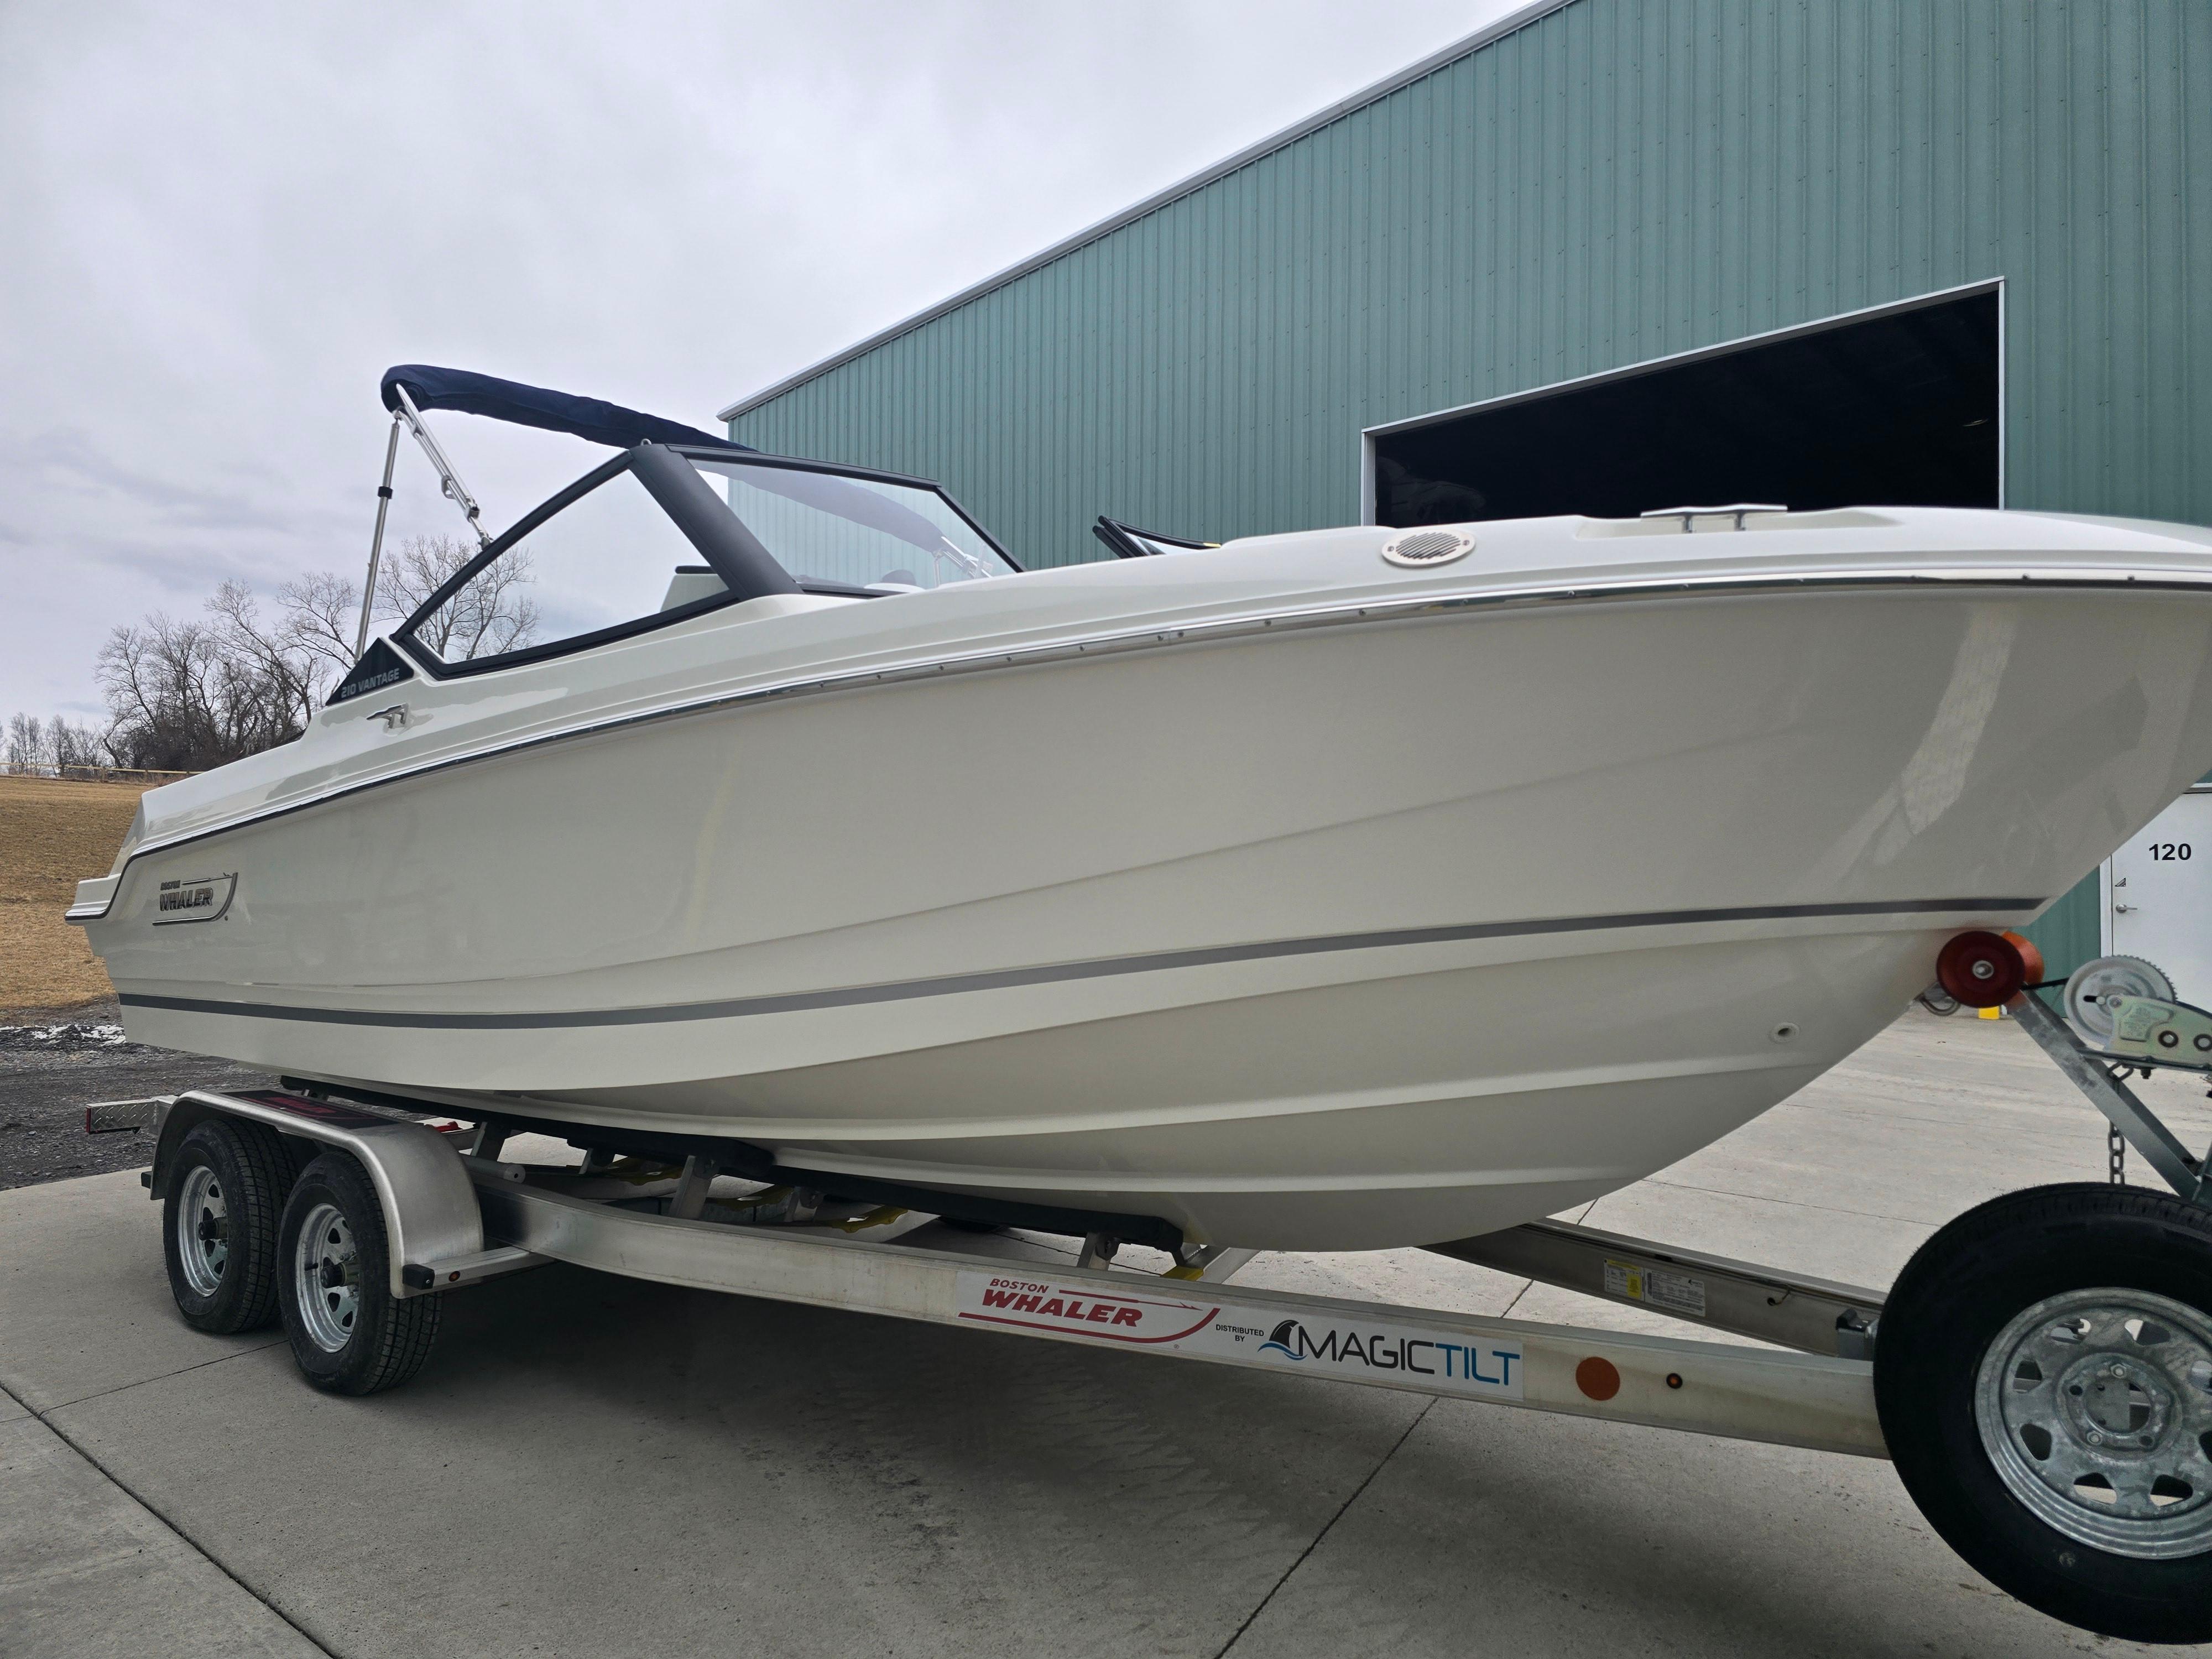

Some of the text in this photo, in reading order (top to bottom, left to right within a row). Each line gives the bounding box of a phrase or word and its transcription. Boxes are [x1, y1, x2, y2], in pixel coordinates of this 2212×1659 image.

[341, 668, 400, 698] 210 VANTAGE
[2148, 843, 2192, 860] 120
[160, 887, 213, 911] WHALER
[989, 1278, 1050, 1293] BOSTON
[982, 1288, 1143, 1327] WHALER
[1215, 1323, 1265, 1337] DISTRIBUTED
[1298, 1325, 1520, 1386] MAGICTILT
